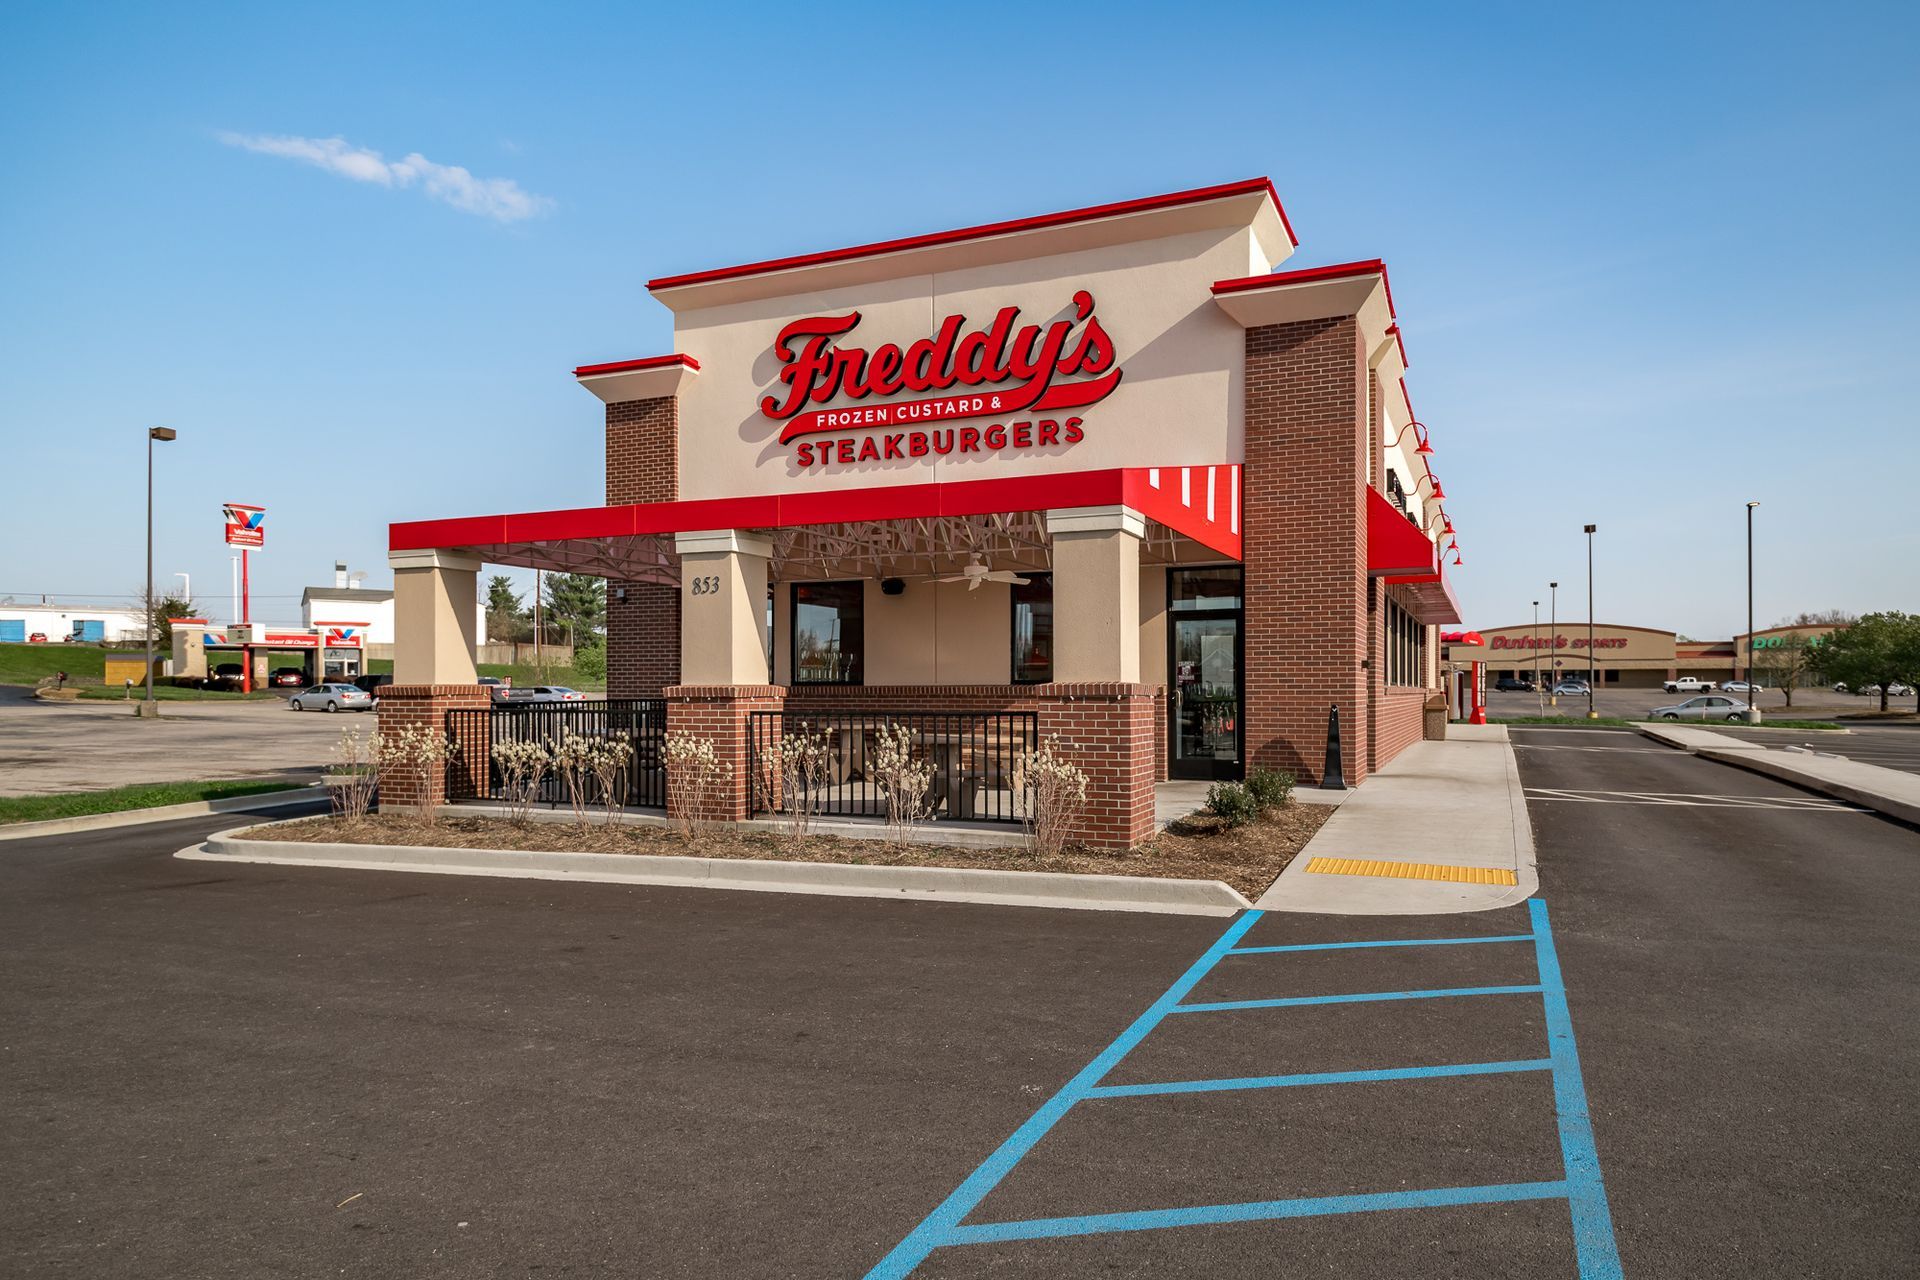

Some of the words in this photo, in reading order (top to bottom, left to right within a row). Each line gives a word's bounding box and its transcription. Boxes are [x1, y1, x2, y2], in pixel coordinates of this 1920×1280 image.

[760, 290, 1121, 420] Freddy's
[816, 408, 888, 428] FROZEN
[896, 397, 984, 420] CUSTARD
[991, 396, 1002, 409] &
[797, 416, 1085, 468] STEAKBURGERS
[691, 576, 720, 595] 853
[1492, 634, 1568, 649] Dunham's
